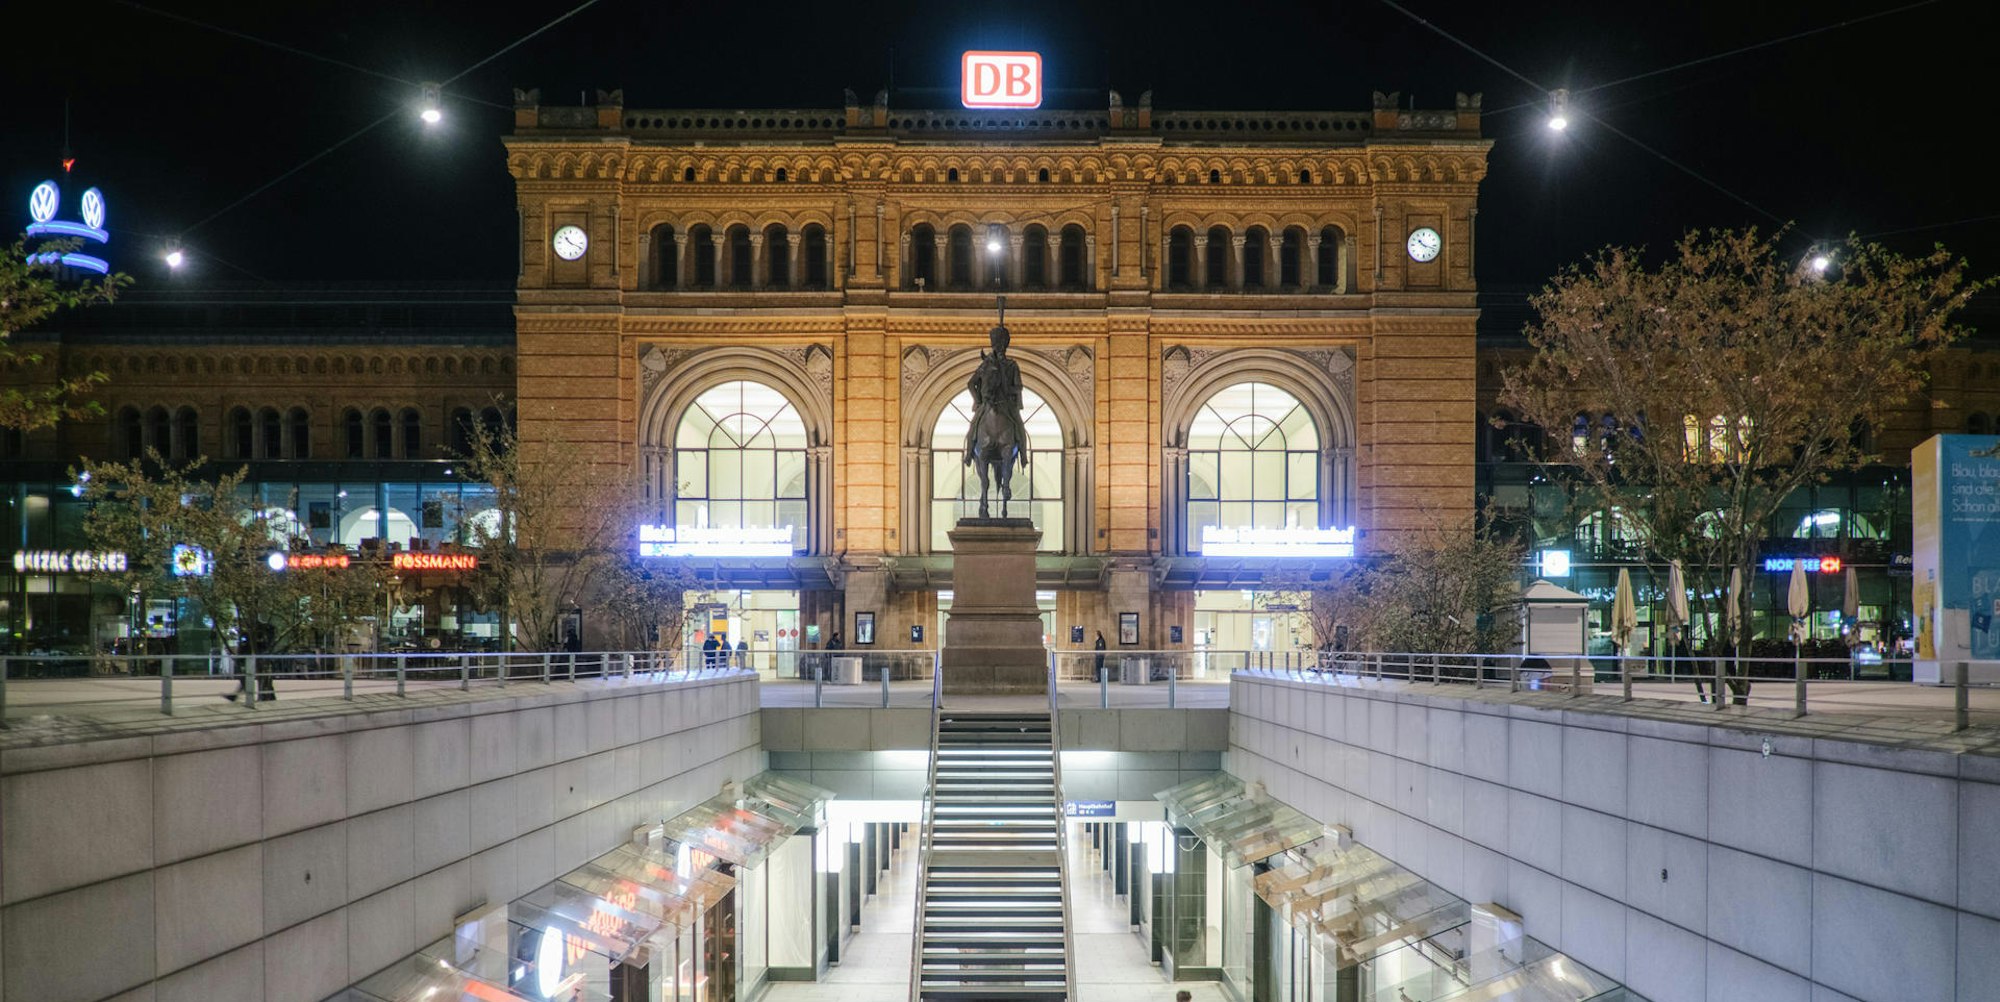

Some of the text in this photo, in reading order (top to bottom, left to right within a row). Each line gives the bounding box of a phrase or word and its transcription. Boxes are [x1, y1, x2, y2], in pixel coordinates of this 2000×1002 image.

[974, 63, 1031, 96] DB
[30, 184, 55, 222] VW
[82, 191, 101, 229] VW
[72, 550, 126, 572] COFEE
[393, 554, 476, 569] ROSSMANN
[1765, 558, 1820, 571] NORSEE
